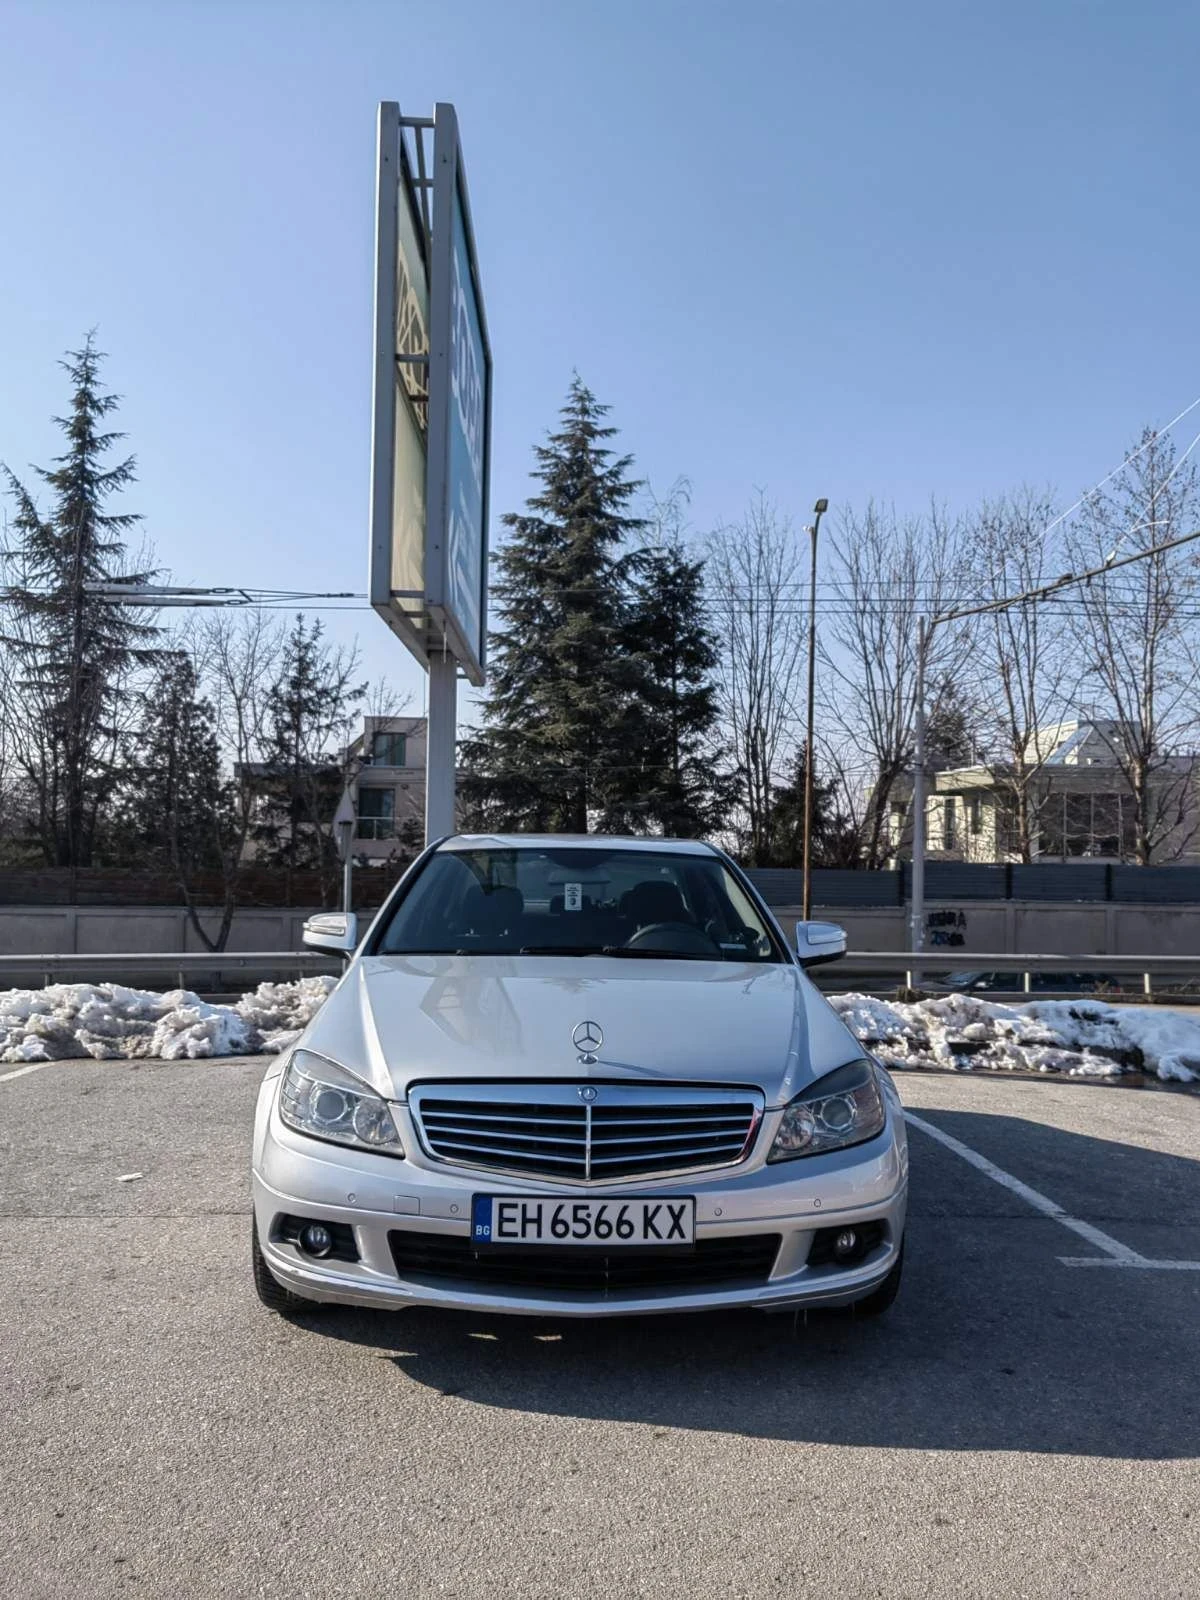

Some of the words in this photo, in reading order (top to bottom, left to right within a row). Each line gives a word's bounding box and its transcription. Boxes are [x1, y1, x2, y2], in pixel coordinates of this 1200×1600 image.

[475, 1224, 491, 1236] BG
[498, 1202, 542, 1239] EH
[551, 1203, 635, 1240] 6566
[643, 1204, 687, 1240] KX
